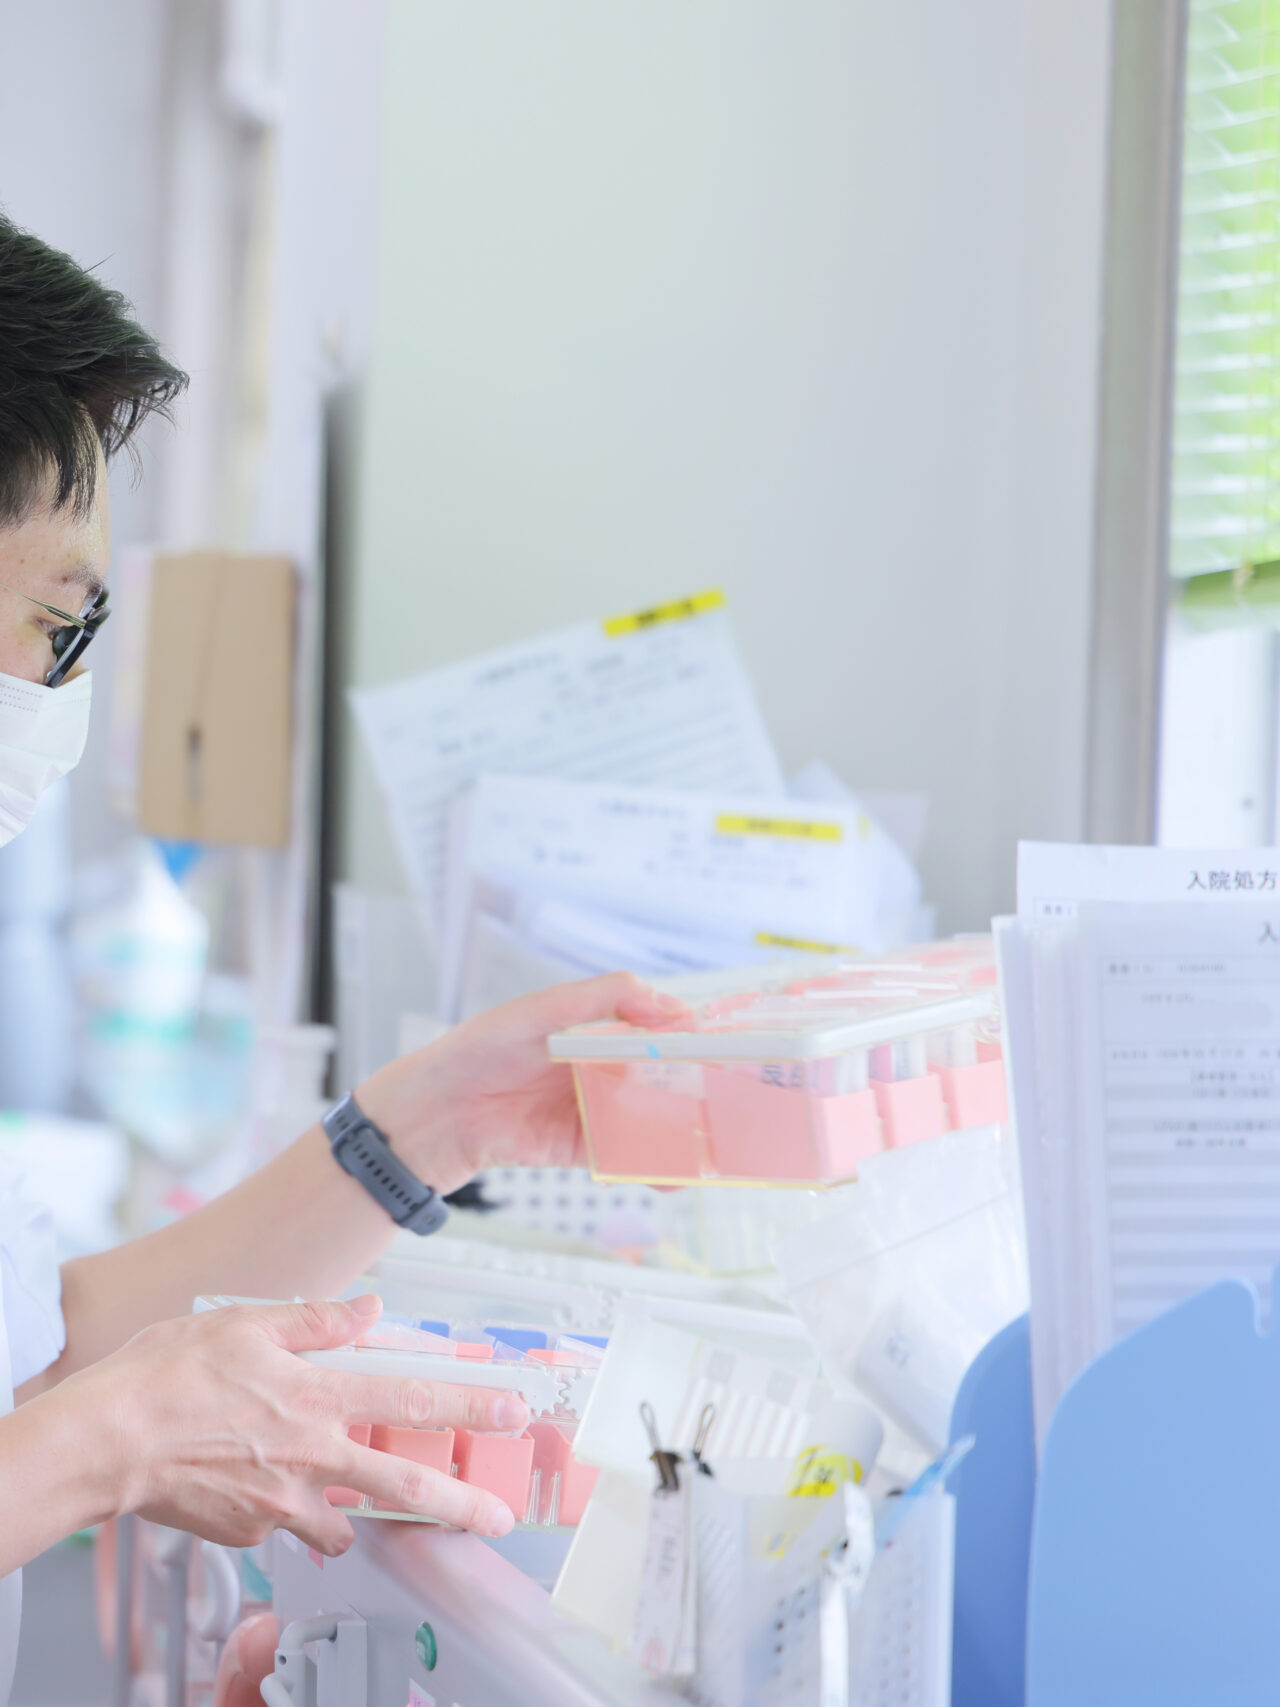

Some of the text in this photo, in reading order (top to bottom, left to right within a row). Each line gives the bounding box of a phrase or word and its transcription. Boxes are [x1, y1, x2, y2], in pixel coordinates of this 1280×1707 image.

[1186, 869, 1278, 891] 入院処方
[1258, 920, 1280, 945] 入
